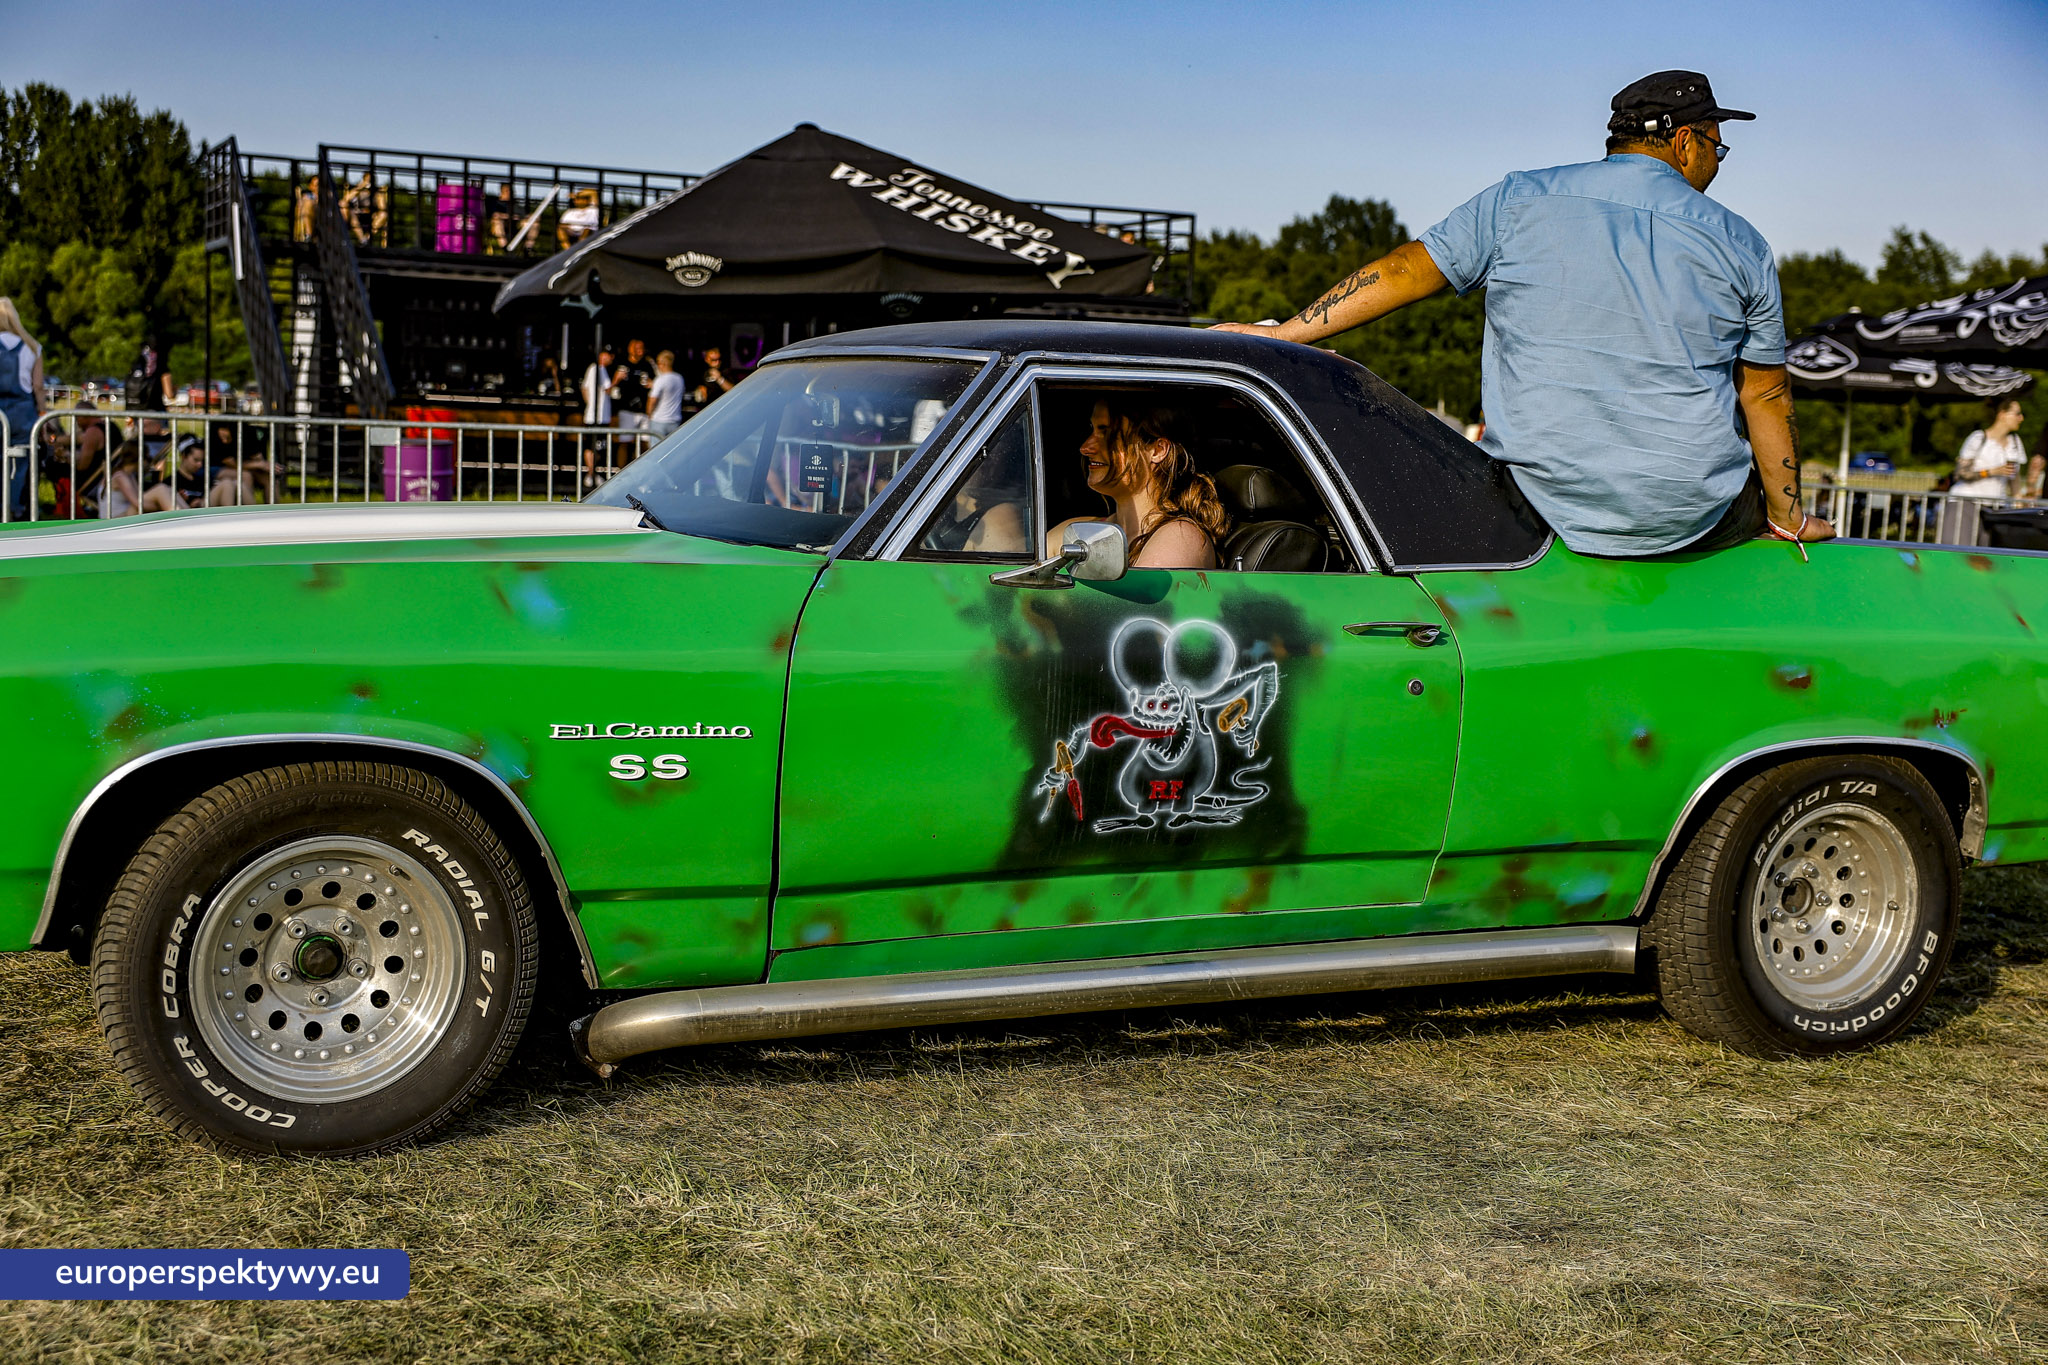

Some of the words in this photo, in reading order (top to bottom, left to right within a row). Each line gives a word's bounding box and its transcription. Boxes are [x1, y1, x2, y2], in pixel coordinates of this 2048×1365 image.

[830, 162, 1095, 289] WHISKEY
[889, 168, 1054, 241] Tennessee
[1299, 293, 1339, 324] Carpe
[1338, 270, 1380, 304] Diem
[549, 723, 594, 739] El
[605, 722, 753, 739] Camino
[609, 754, 691, 780] SS
[1149, 780, 1183, 799] RF
[1754, 786, 1830, 867] Radial
[1840, 781, 1878, 797] T/A
[162, 893, 202, 1019] COBRA
[402, 828, 490, 932] RADIAL
[475, 950, 496, 1018] G/T
[1793, 930, 1939, 1035] BFGoodrich
[173, 1035, 297, 1129] COOPER
